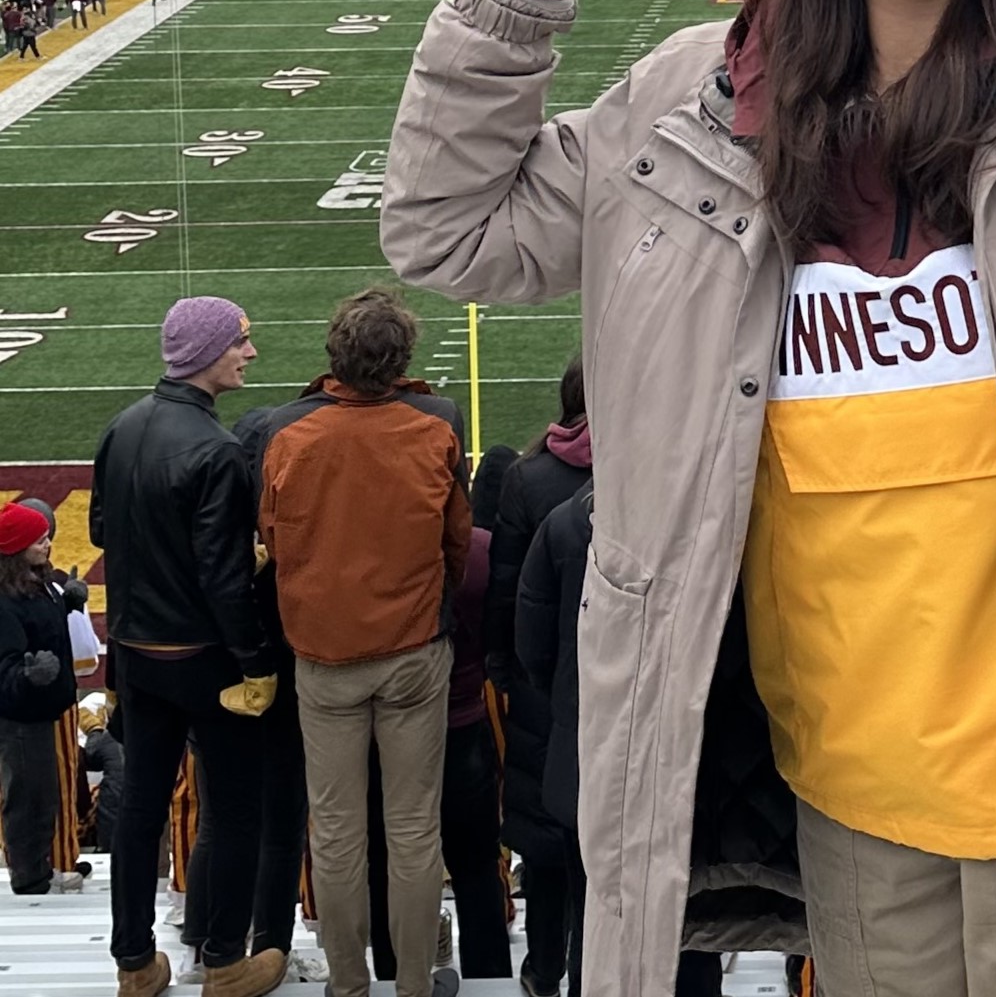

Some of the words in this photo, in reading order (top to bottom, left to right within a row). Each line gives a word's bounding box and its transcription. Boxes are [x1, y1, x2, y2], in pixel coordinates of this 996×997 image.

[261, 66, 331, 90] 40
[181, 130, 265, 157] 30
[83, 209, 179, 242] 20
[779, 270, 979, 377] INNESO
